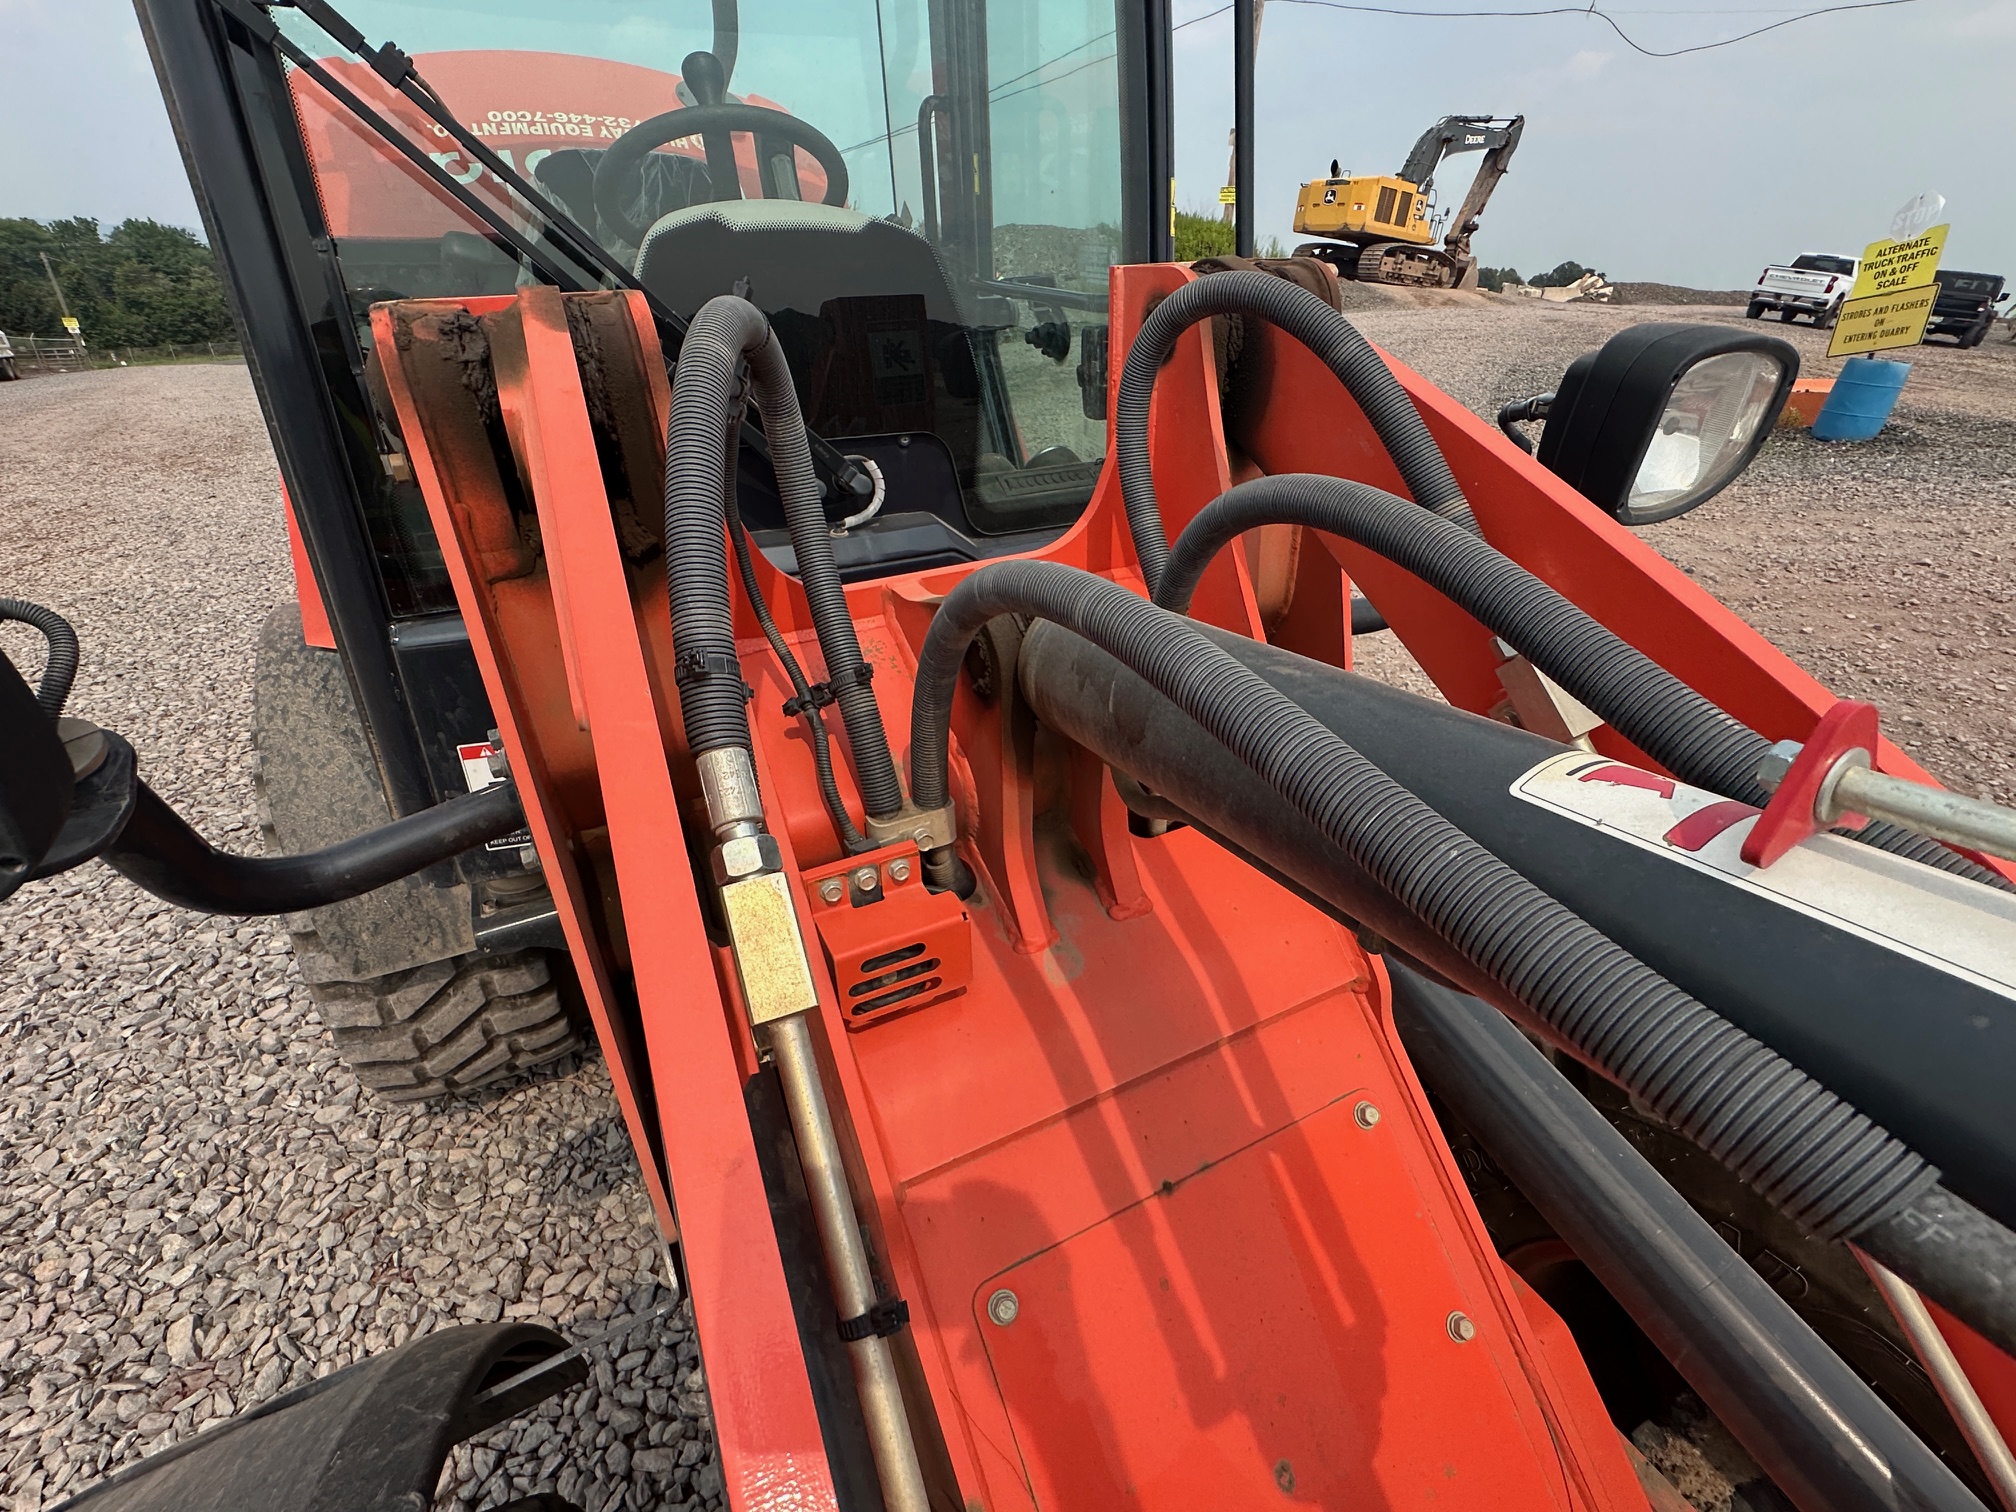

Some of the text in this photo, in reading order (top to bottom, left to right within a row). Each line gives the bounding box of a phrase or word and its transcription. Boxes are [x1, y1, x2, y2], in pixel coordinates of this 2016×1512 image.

[1464, 134, 1486, 145] DEERE
[1892, 205, 1939, 230] STOP
[1876, 236, 1931, 258] ALTERNATE
[1863, 246, 1938, 272] TRUCK TRAFFIC
[1769, 273, 1826, 284] CHEVROLET
[1873, 261, 1919, 280] ON & OFF
[1876, 275, 1908, 290] SCALE
[1841, 298, 1930, 321] STROBES AND FLASHERS
[1874, 318, 1886, 327] ON
[1843, 325, 1911, 344] ENTERING QUARRY
